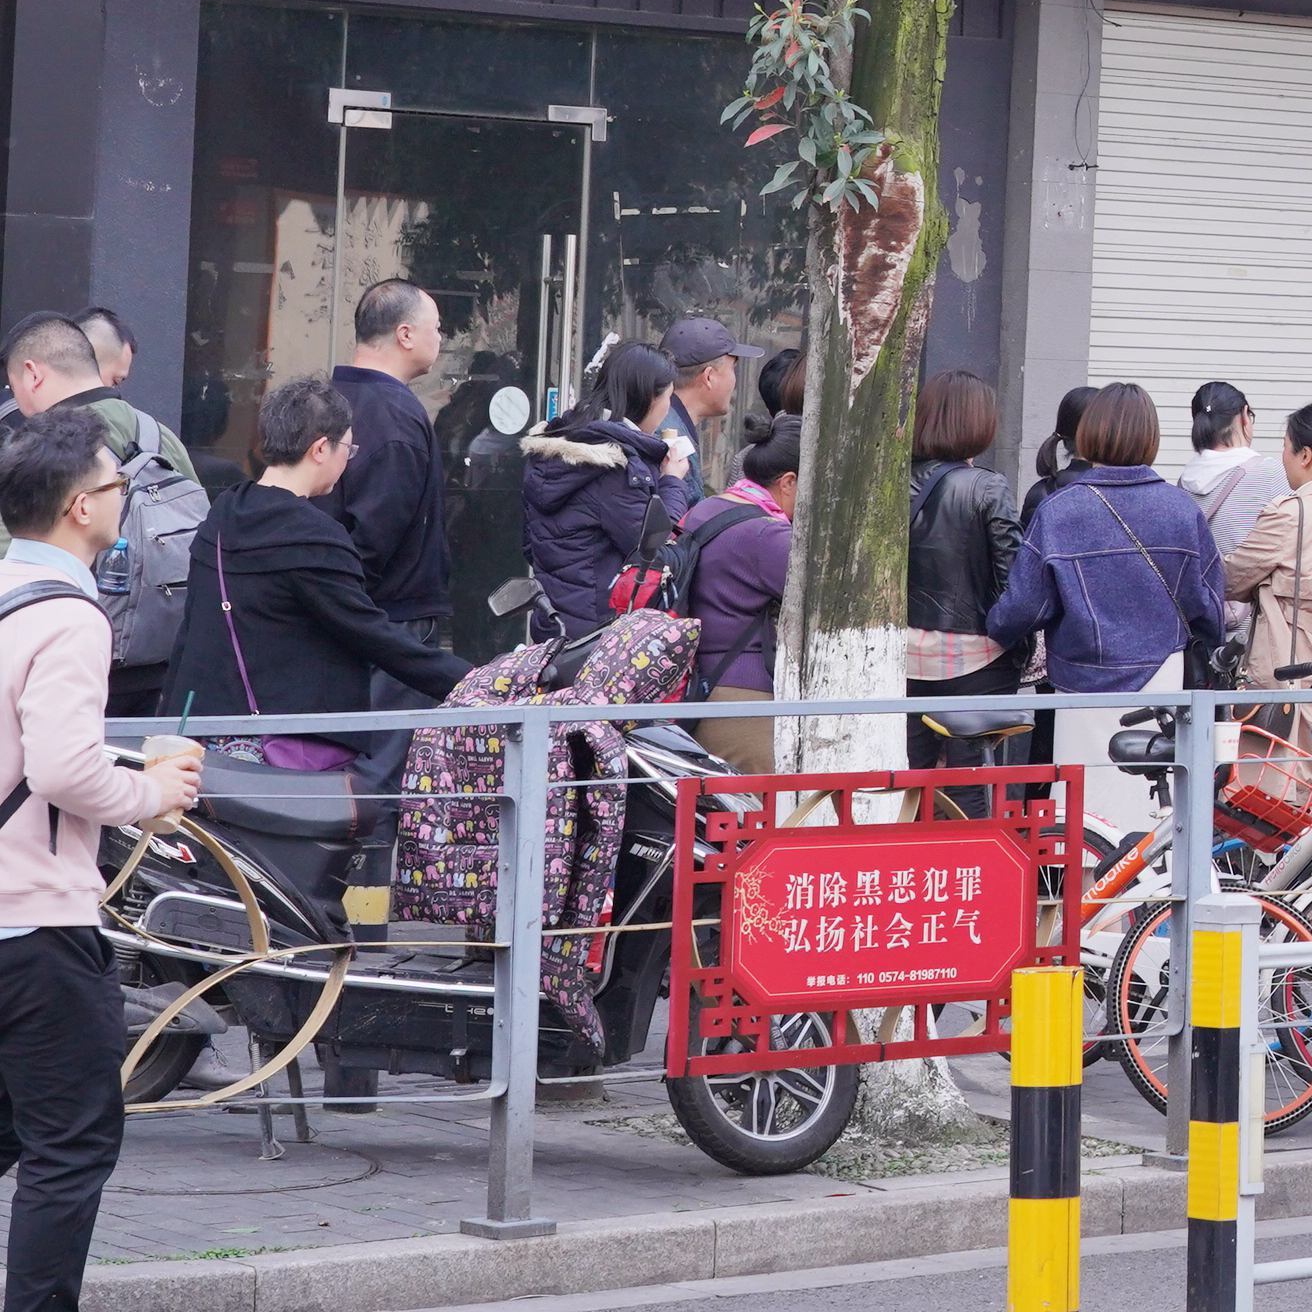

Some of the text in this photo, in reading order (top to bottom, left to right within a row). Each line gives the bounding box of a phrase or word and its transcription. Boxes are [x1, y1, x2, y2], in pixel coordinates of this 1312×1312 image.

[784, 865, 983, 911] 消除黑恶犯罪
[1082, 845, 1140, 902] mobike
[783, 907, 982, 954] 弘扬社会正气
[856, 972, 875, 985] 110
[878, 967, 958, 984] 0574-81987110
